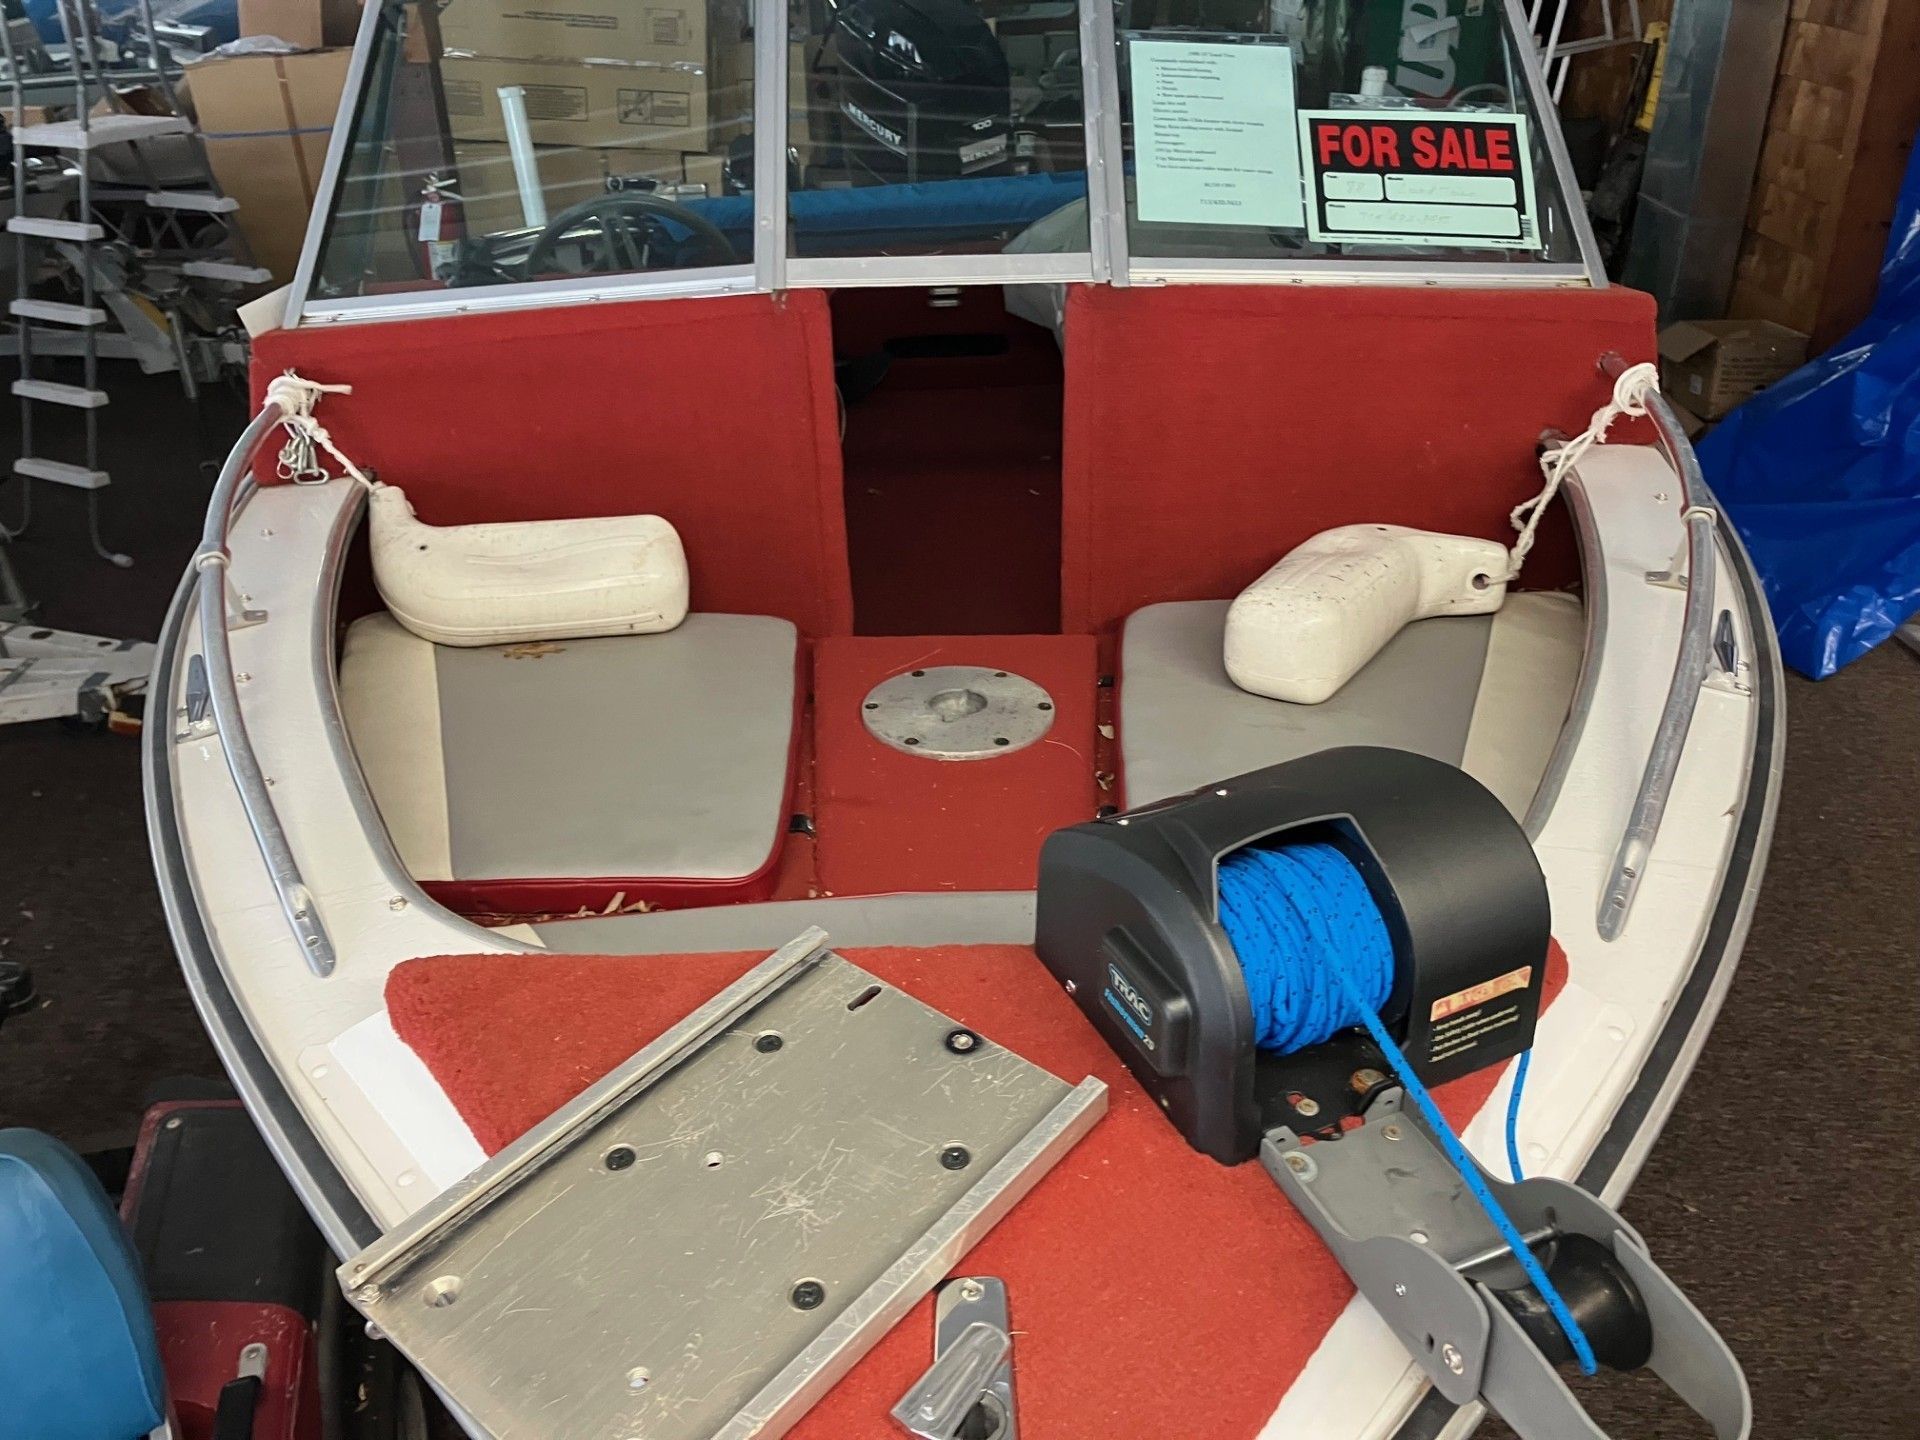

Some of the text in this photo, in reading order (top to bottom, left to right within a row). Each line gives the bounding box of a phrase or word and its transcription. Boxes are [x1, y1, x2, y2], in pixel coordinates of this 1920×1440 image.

[848, 102, 902, 145] MERCURY
[1317, 124, 1514, 170] FOR SALE
[1110, 968, 1151, 1022] TRAC
